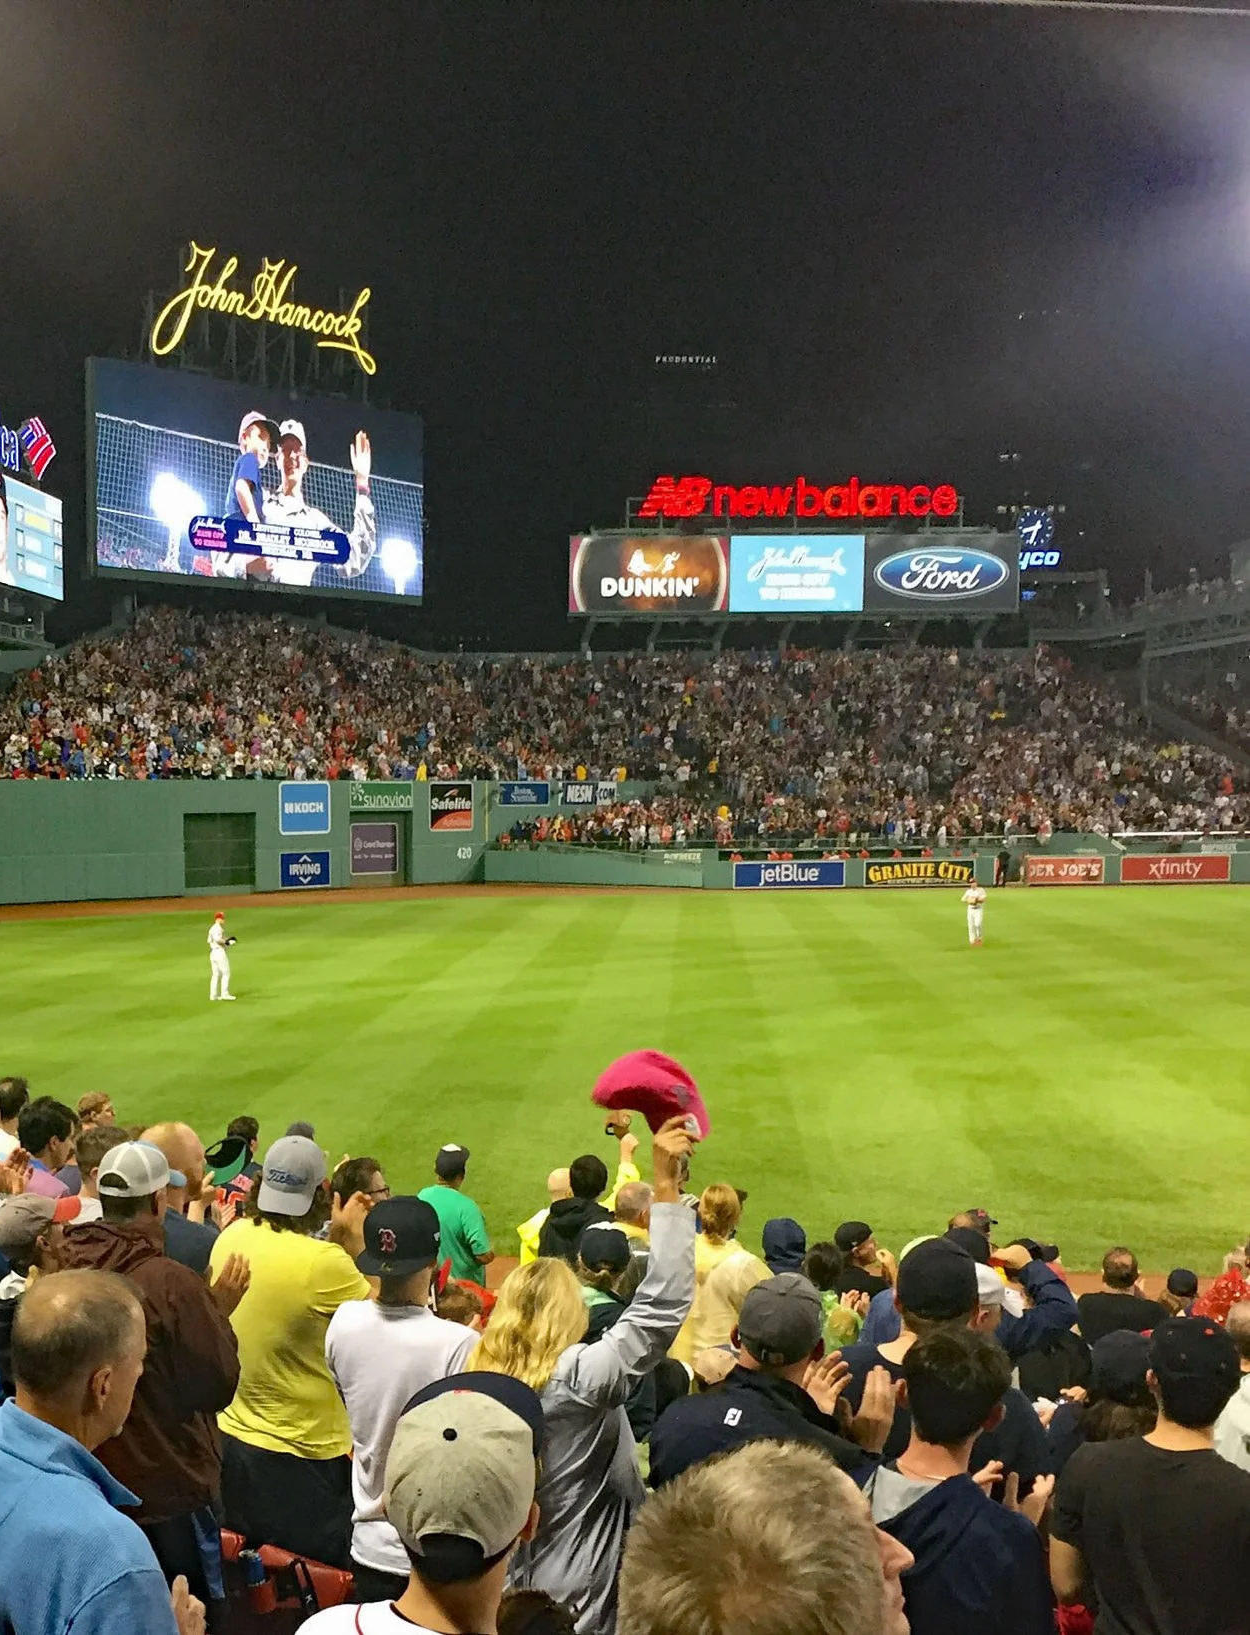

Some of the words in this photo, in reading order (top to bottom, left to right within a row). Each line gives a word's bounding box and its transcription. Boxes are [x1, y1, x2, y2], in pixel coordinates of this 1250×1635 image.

[152, 240, 246, 355] John
[244, 257, 377, 375] Hancock
[713, 484, 794, 517] new
[795, 477, 959, 518] balance
[901, 553, 981, 590] Ford
[600, 576, 700, 598] DUNKIN'
[364, 792, 411, 807] sunovion
[566, 785, 594, 803] NESN
[295, 802, 324, 813] KOCH
[431, 797, 471, 810] Safelite
[457, 847, 472, 859] 420
[289, 863, 321, 876] IRVING
[759, 863, 820, 885] jetBlue
[868, 863, 935, 882] GRANITE
[938, 862, 973, 881] CITY
[1059, 863, 1101, 876] JOE'S
[1149, 859, 1203, 878] xfinity
